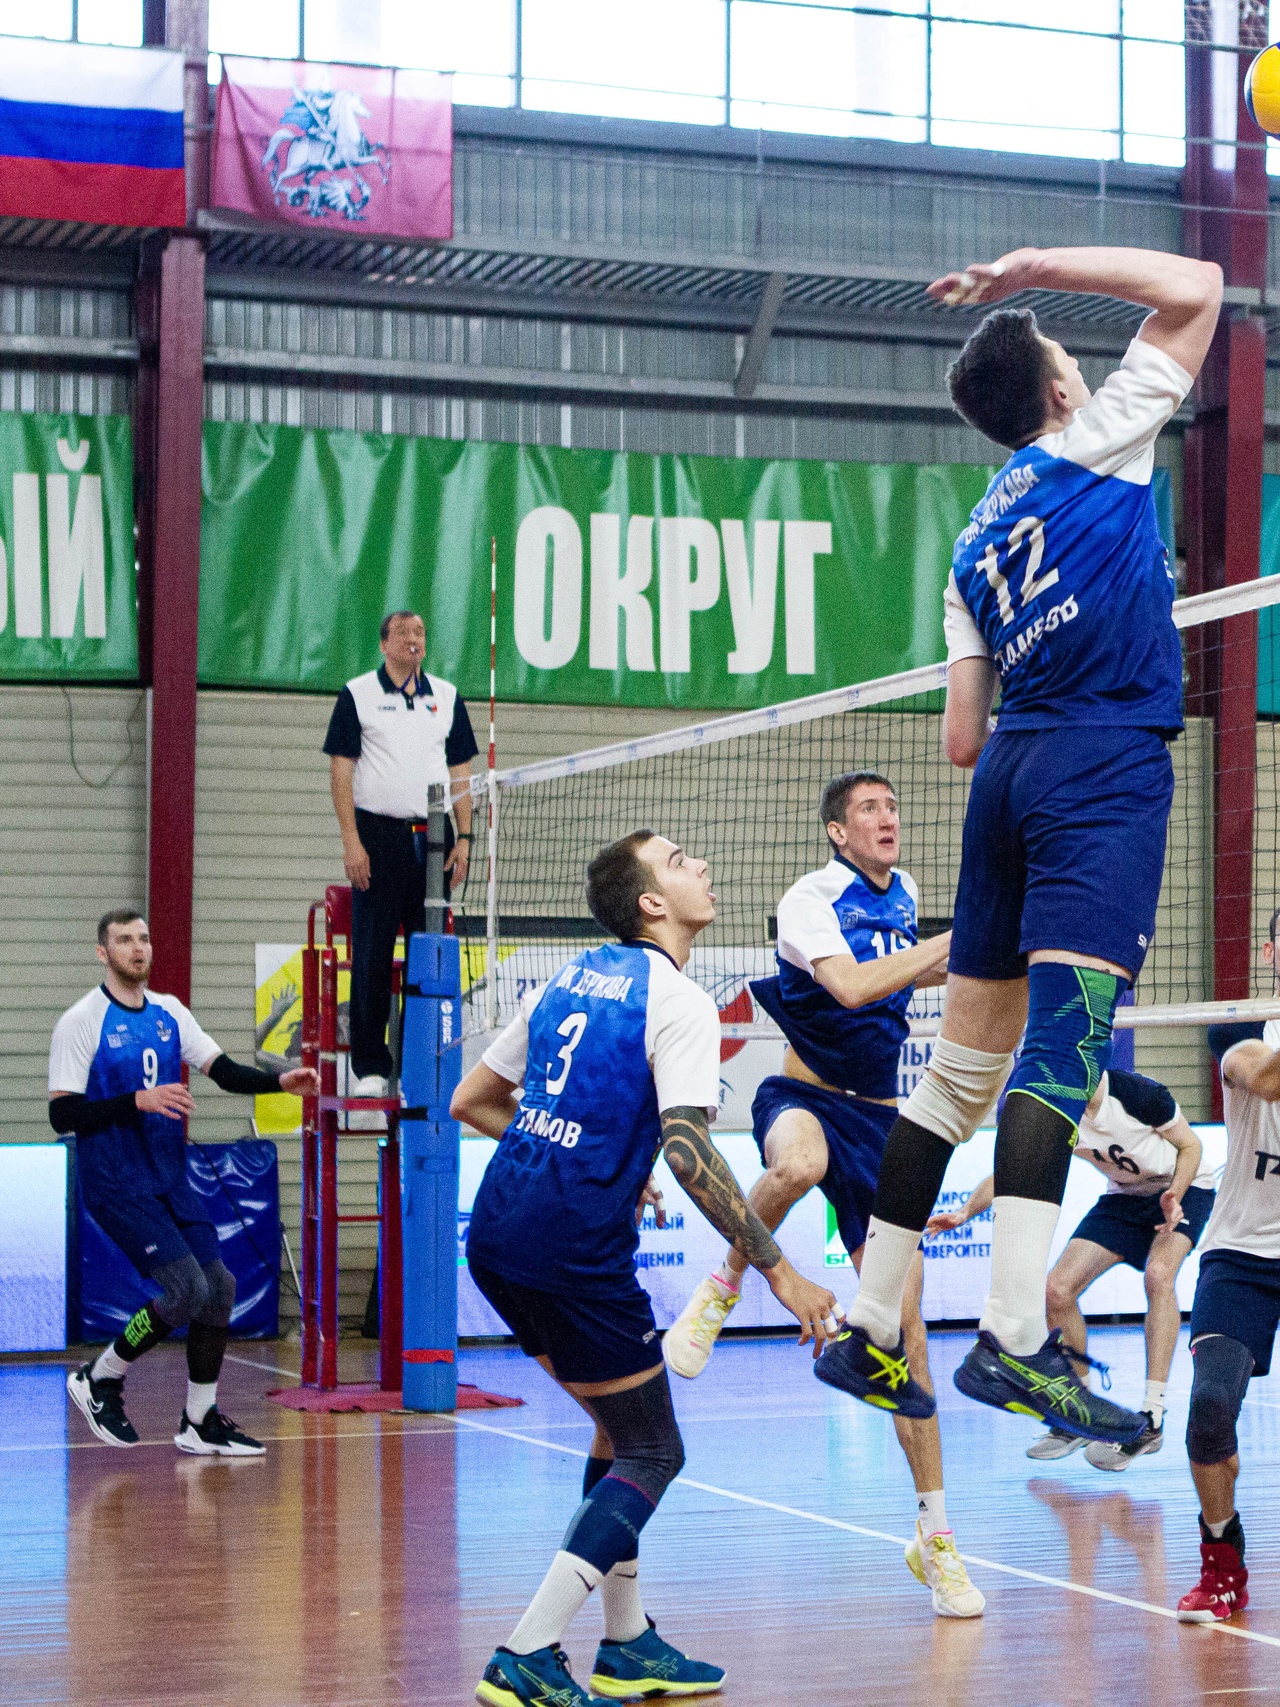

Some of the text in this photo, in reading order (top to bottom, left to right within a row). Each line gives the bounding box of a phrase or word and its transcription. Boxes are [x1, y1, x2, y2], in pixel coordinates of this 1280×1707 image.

[514, 506, 833, 676] ОКРУГ
[975, 516, 1060, 627] 12
[571, 968, 634, 1003] ДЕРЖАВА
[142, 1047, 158, 1091] 9
[546, 1012, 588, 1096] 3
